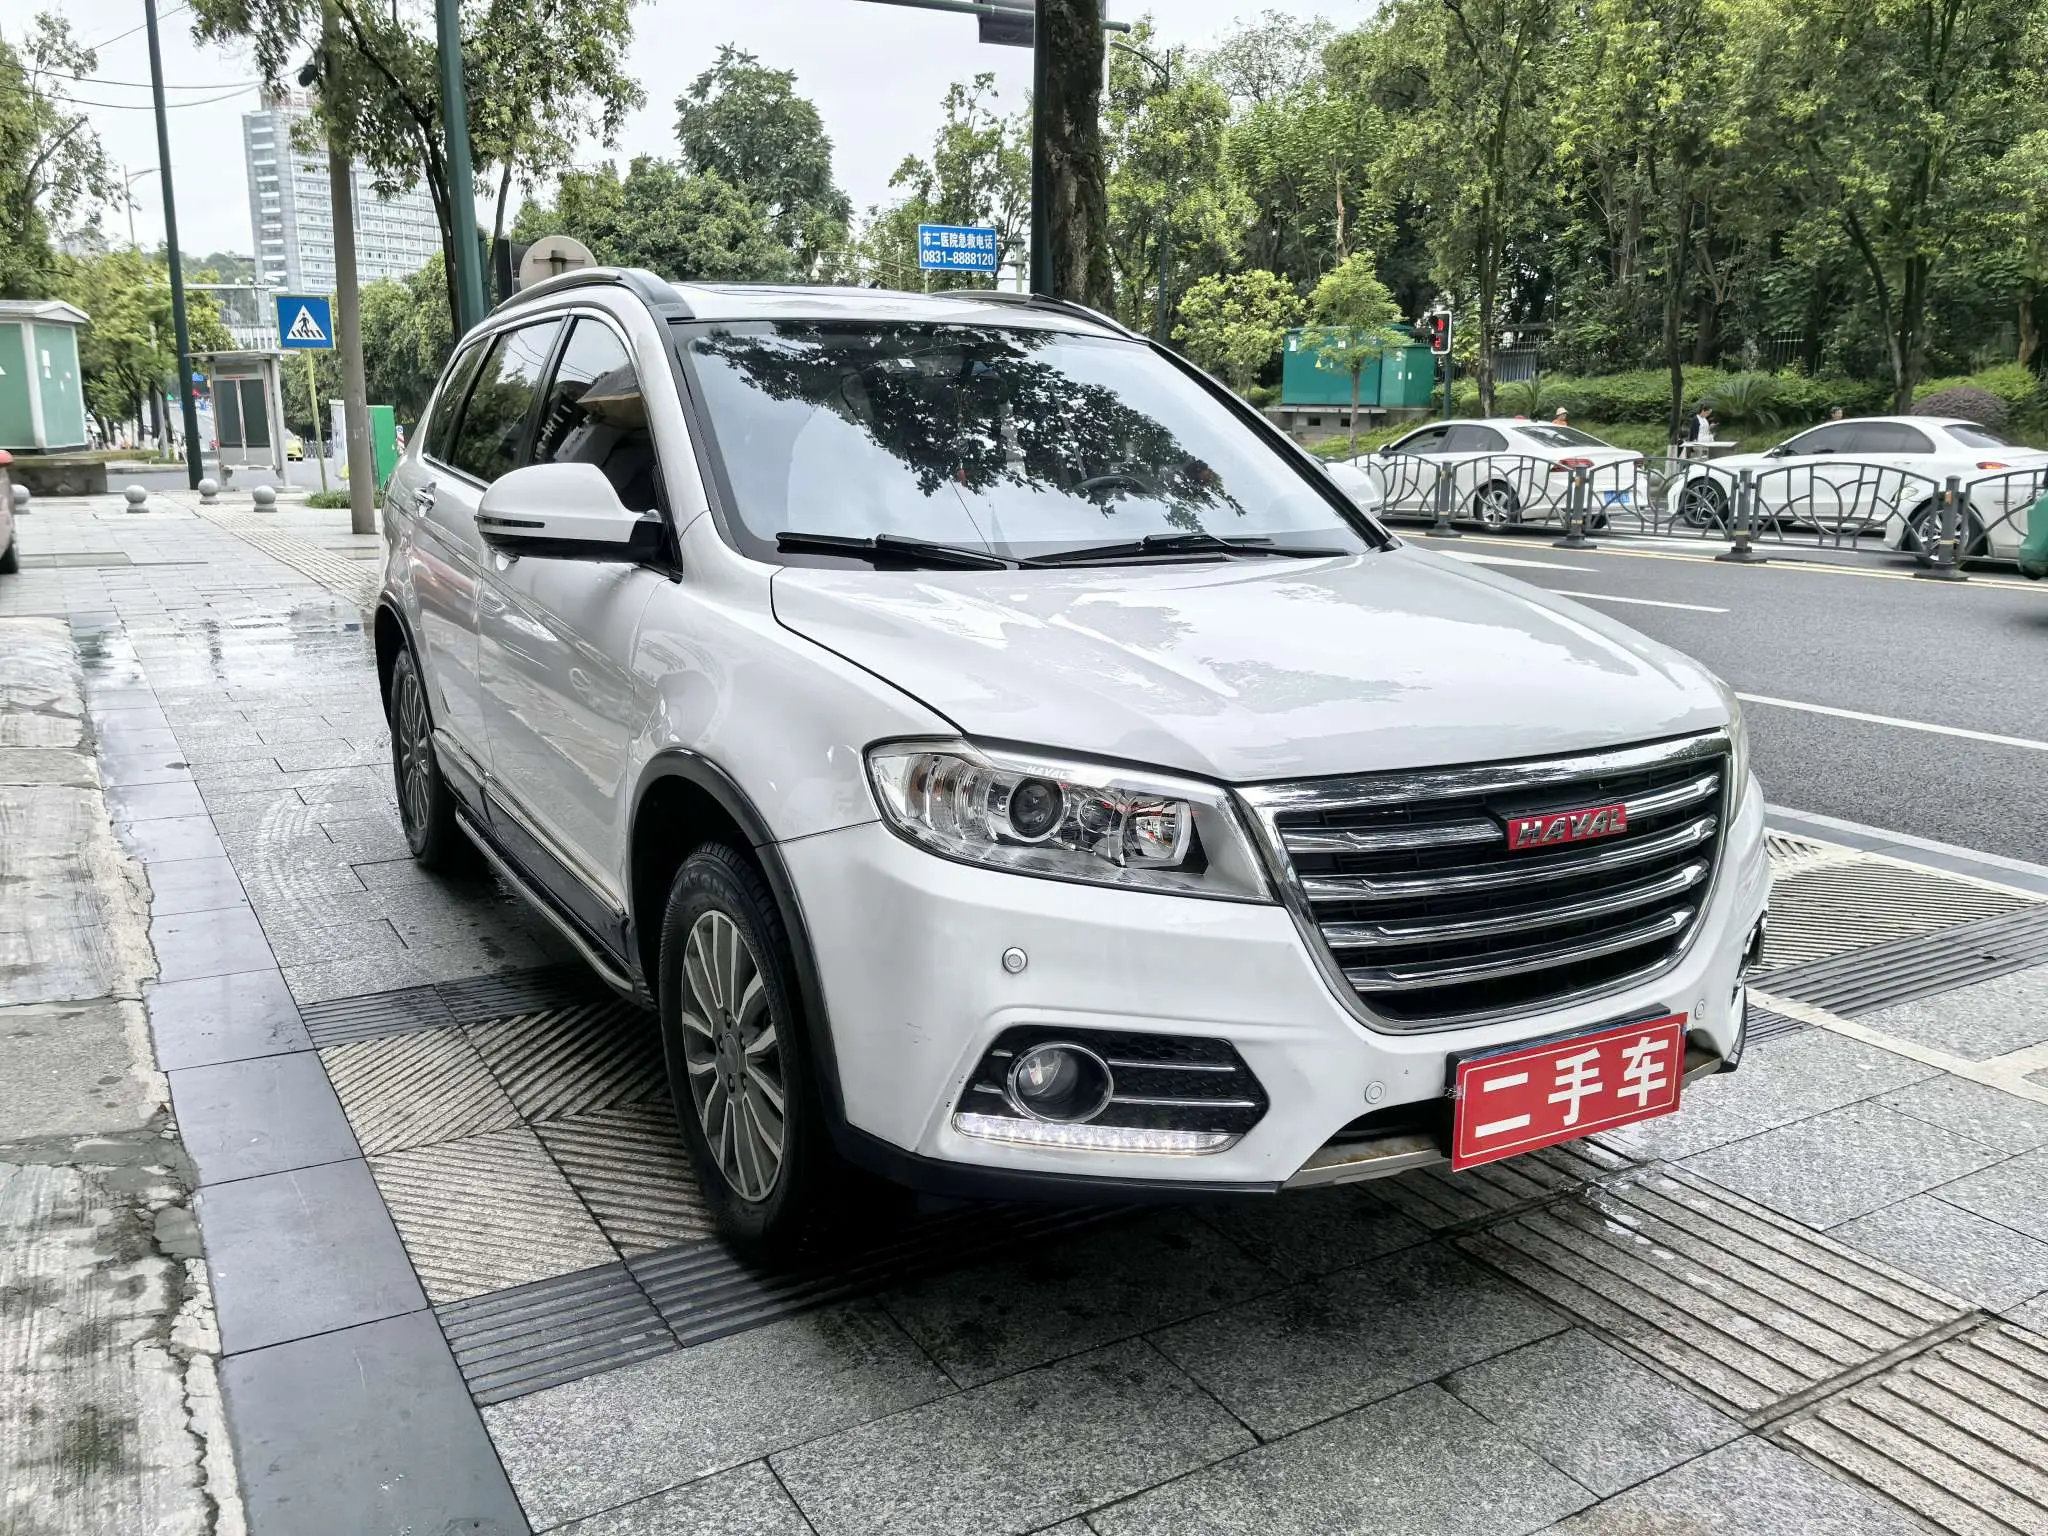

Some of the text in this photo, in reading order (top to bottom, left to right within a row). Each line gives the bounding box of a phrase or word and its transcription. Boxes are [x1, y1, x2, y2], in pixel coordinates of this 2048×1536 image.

[923, 231, 993, 249] 市二医院急救电话
[923, 250, 993, 265] 0831-8888120
[1027, 765, 1066, 779] HAVAL
[1517, 809, 1625, 846] HAVAL
[1475, 1037, 1669, 1138] 二手车
